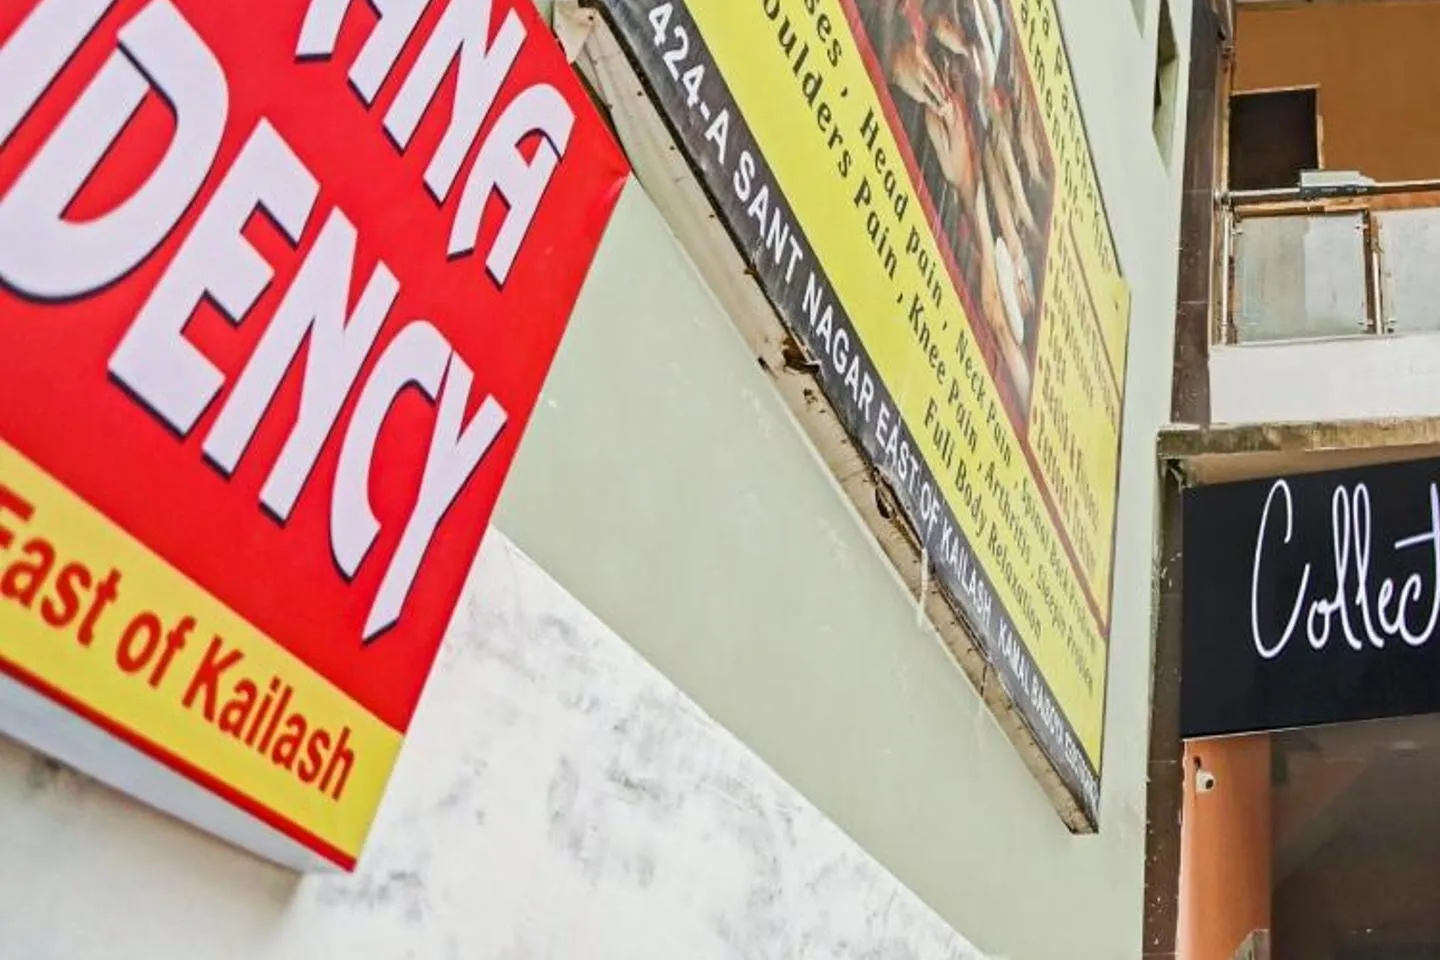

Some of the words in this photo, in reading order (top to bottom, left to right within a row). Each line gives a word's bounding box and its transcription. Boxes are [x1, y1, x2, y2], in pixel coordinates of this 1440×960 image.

[648, 2, 730, 165] 424-A
[733, 150, 804, 284] SANT
[802, 271, 875, 423] NAGAR
[875, 401, 919, 496] EAST
[919, 481, 941, 533] OF
[940, 517, 992, 626] KAILASH
[997, 618, 1030, 696] KAMAL
[859, 107, 909, 223] Head
[955, 329, 986, 409] Neck
[985, 399, 1012, 468] Pain
[907, 292, 946, 385] Knee
[923, 397, 955, 469] Full
[954, 457, 988, 538] Body
[987, 520, 1042, 641] Relaxation
[115, 611, 196, 689] of
[181, 634, 355, 802] Kailash
